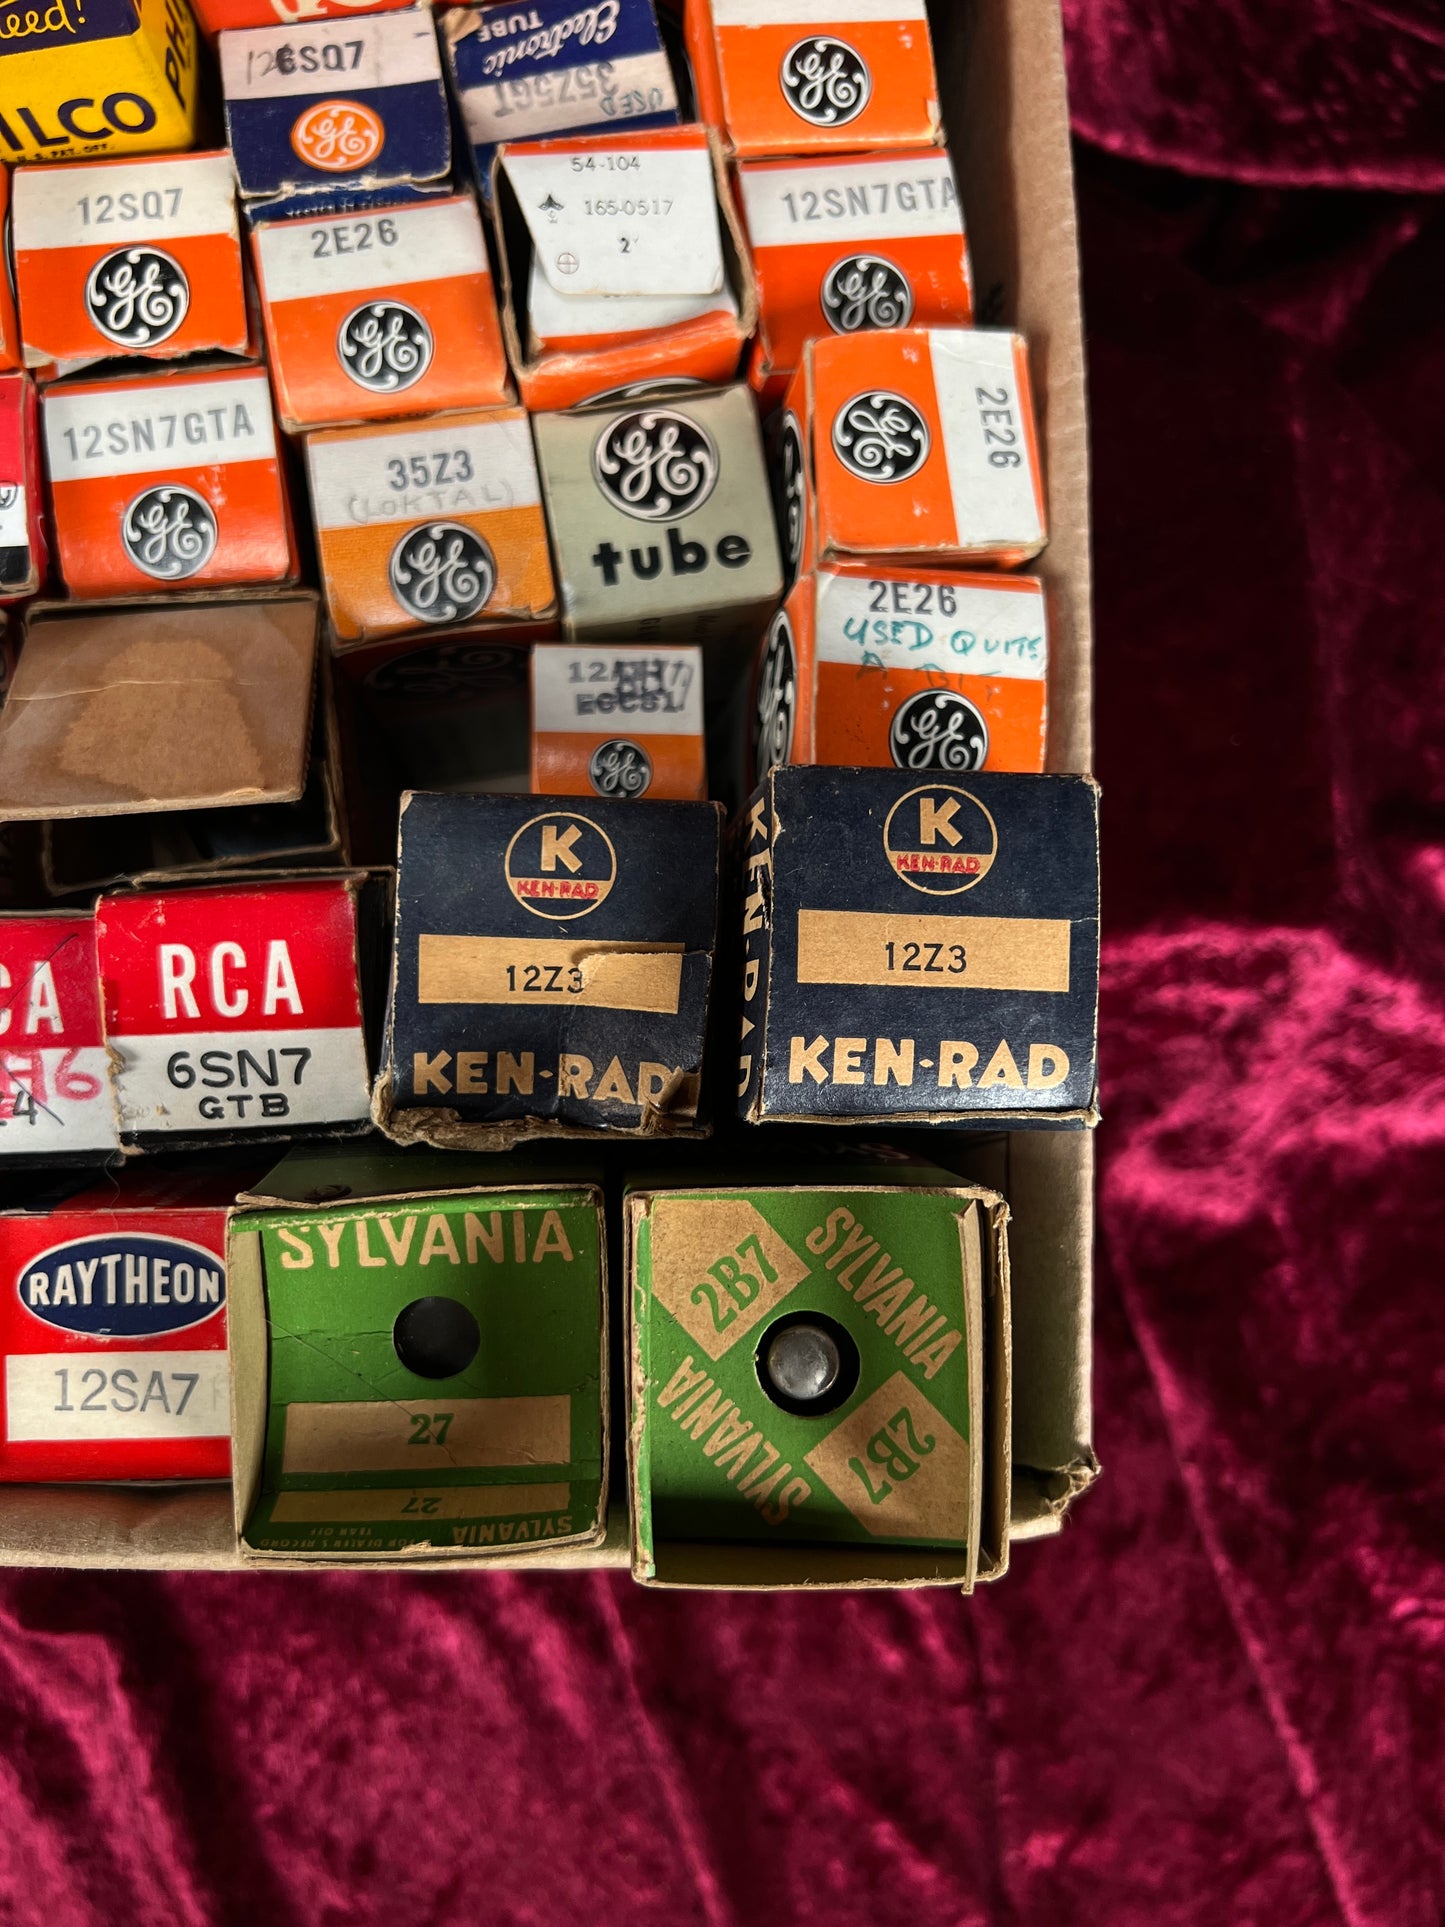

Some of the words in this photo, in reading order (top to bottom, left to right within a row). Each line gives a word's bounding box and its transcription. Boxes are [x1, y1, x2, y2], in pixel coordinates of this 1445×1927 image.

[482, 0, 620, 77] Electronic
[571, 155, 641, 172] 54-104
[77, 188, 184, 226] 12SQ7
[584, 199, 674, 216] 165-0517
[782, 176, 957, 223] 12SN7GTA
[311, 219, 399, 259] 2E26
[63, 404, 255, 462] 12SN7GTA
[975, 386, 1021, 470] 2E26
[388, 450, 475, 492] 35Z3
[592, 528, 752, 587] tube
[868, 580, 957, 618] 2E26
[843, 617, 934, 650] USED
[919, 796, 963, 847] K
[541, 824, 583, 873] K
[160, 939, 304, 1020] RCA
[885, 941, 968, 973] 12Z3
[167, 1047, 313, 1089] 6SN7
[199, 1093, 291, 1119] GTB
[281, 1210, 574, 1269] SYLVANIA
[28, 1253, 220, 1305] RAYTHEON
[690, 1234, 779, 1333] 2B7
[806, 1207, 962, 1380] SYLVANIA
[54, 1369, 199, 1416] 12SA7
[408, 1413, 454, 1445] 27
[657, 1355, 812, 1525] SYLVANIA
[848, 1406, 936, 1504] 2B7
[402, 1496, 442, 1514] 27
[452, 1515, 572, 1544] SYLVANIA
